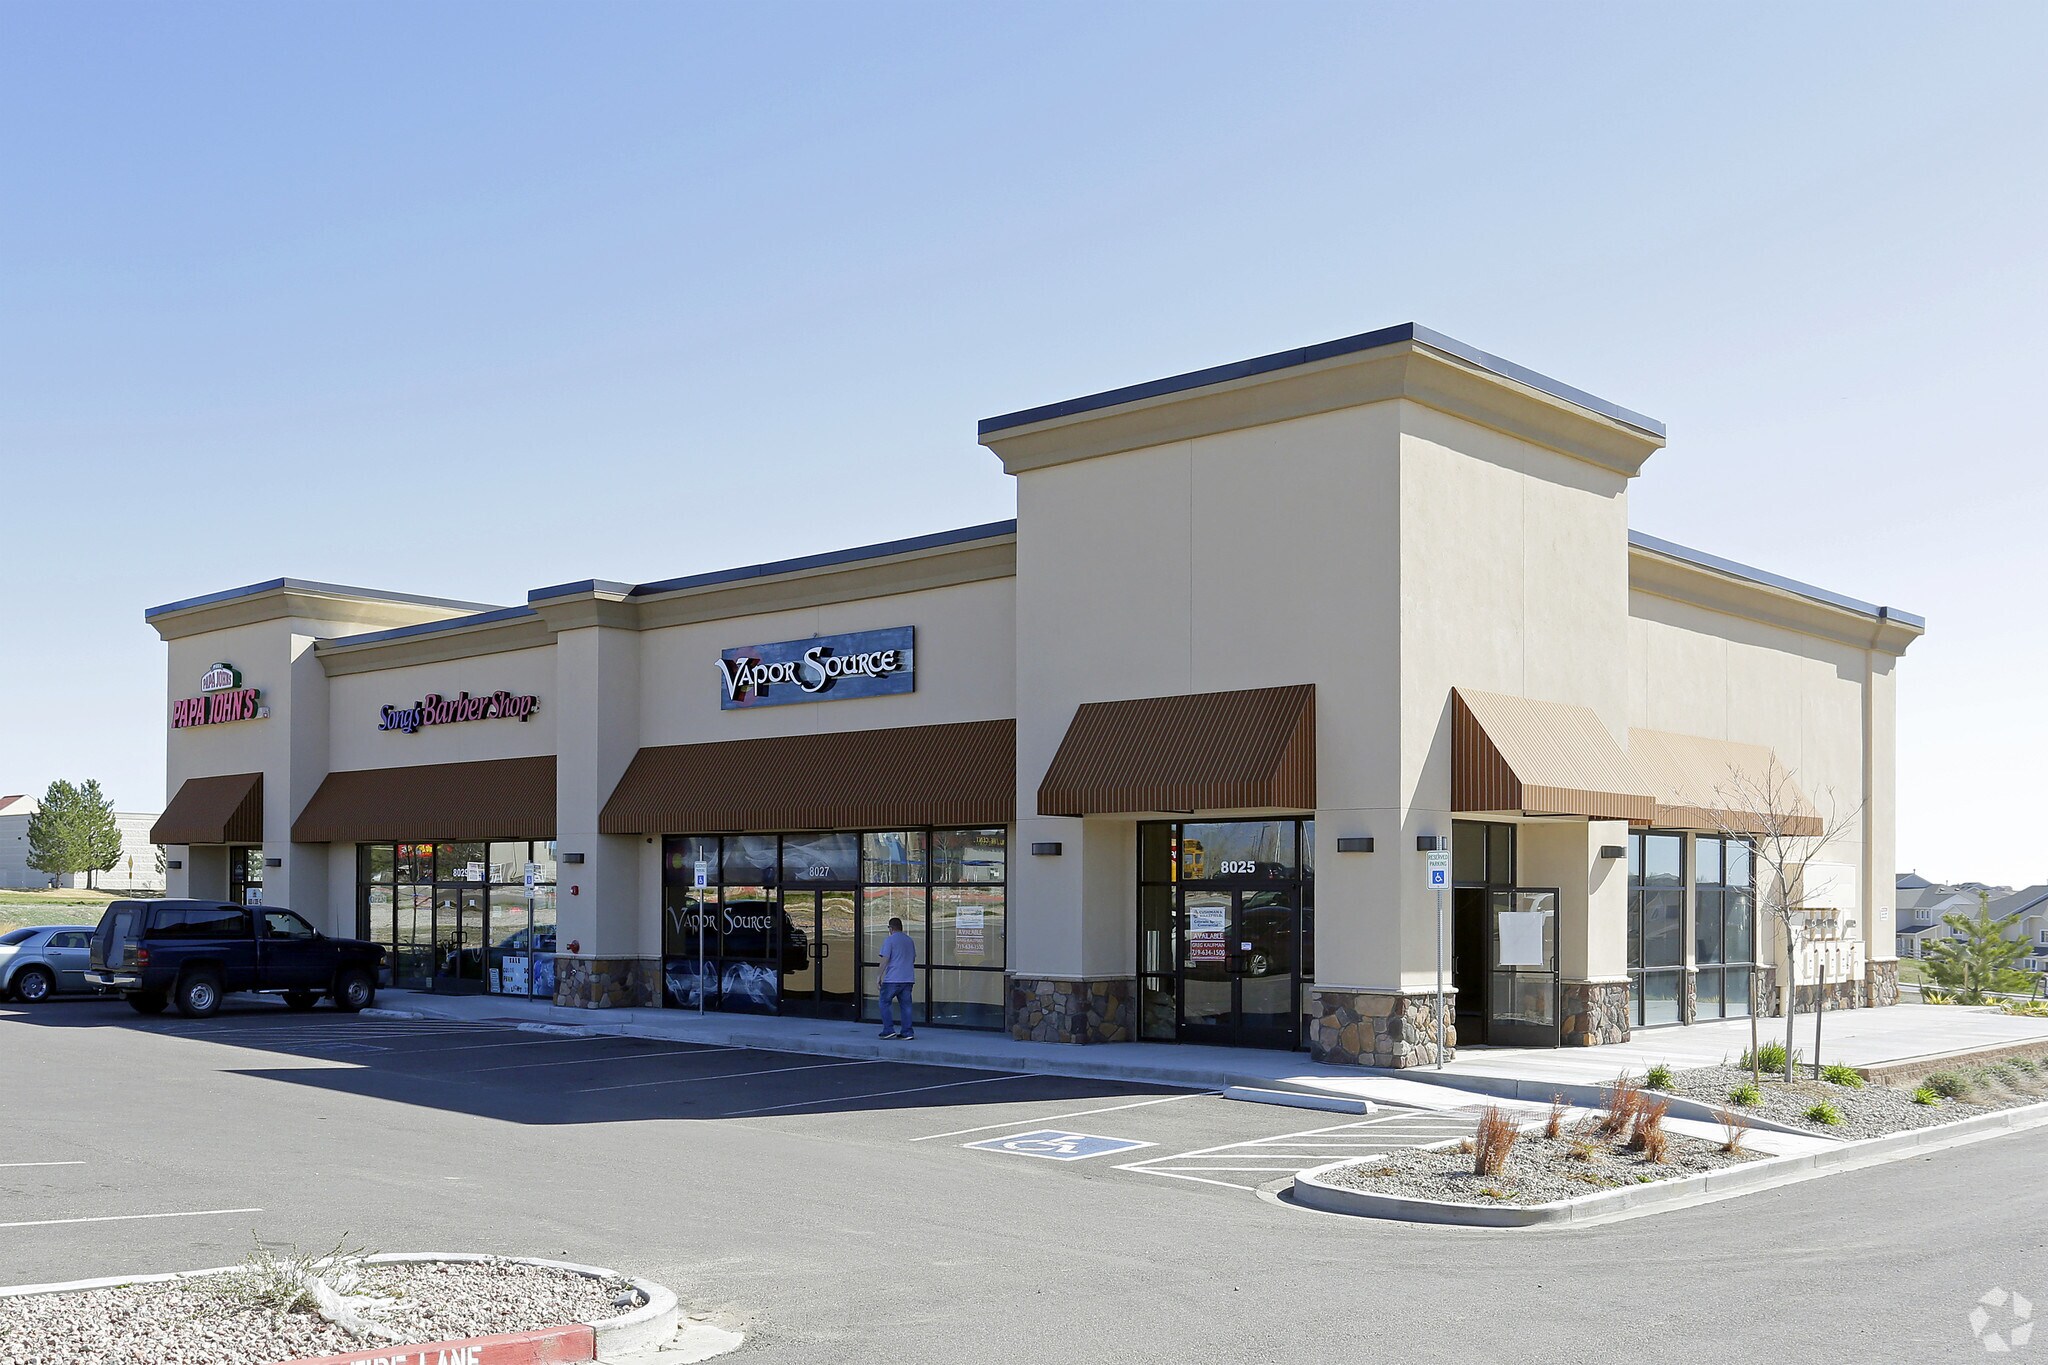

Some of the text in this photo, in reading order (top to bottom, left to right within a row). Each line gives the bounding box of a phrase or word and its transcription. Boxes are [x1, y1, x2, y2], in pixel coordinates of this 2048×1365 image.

[714, 646, 898, 701] VAPOR SOURCE
[171, 687, 258, 729] PAPA JOHN'S
[378, 690, 533, 734] Song's Barber Shop
[809, 865, 830, 878] 8027
[1220, 860, 1256, 874] 8025
[667, 906, 773, 935] VAPOR SOURCE
[1193, 932, 1224, 940] AVAILABLE
